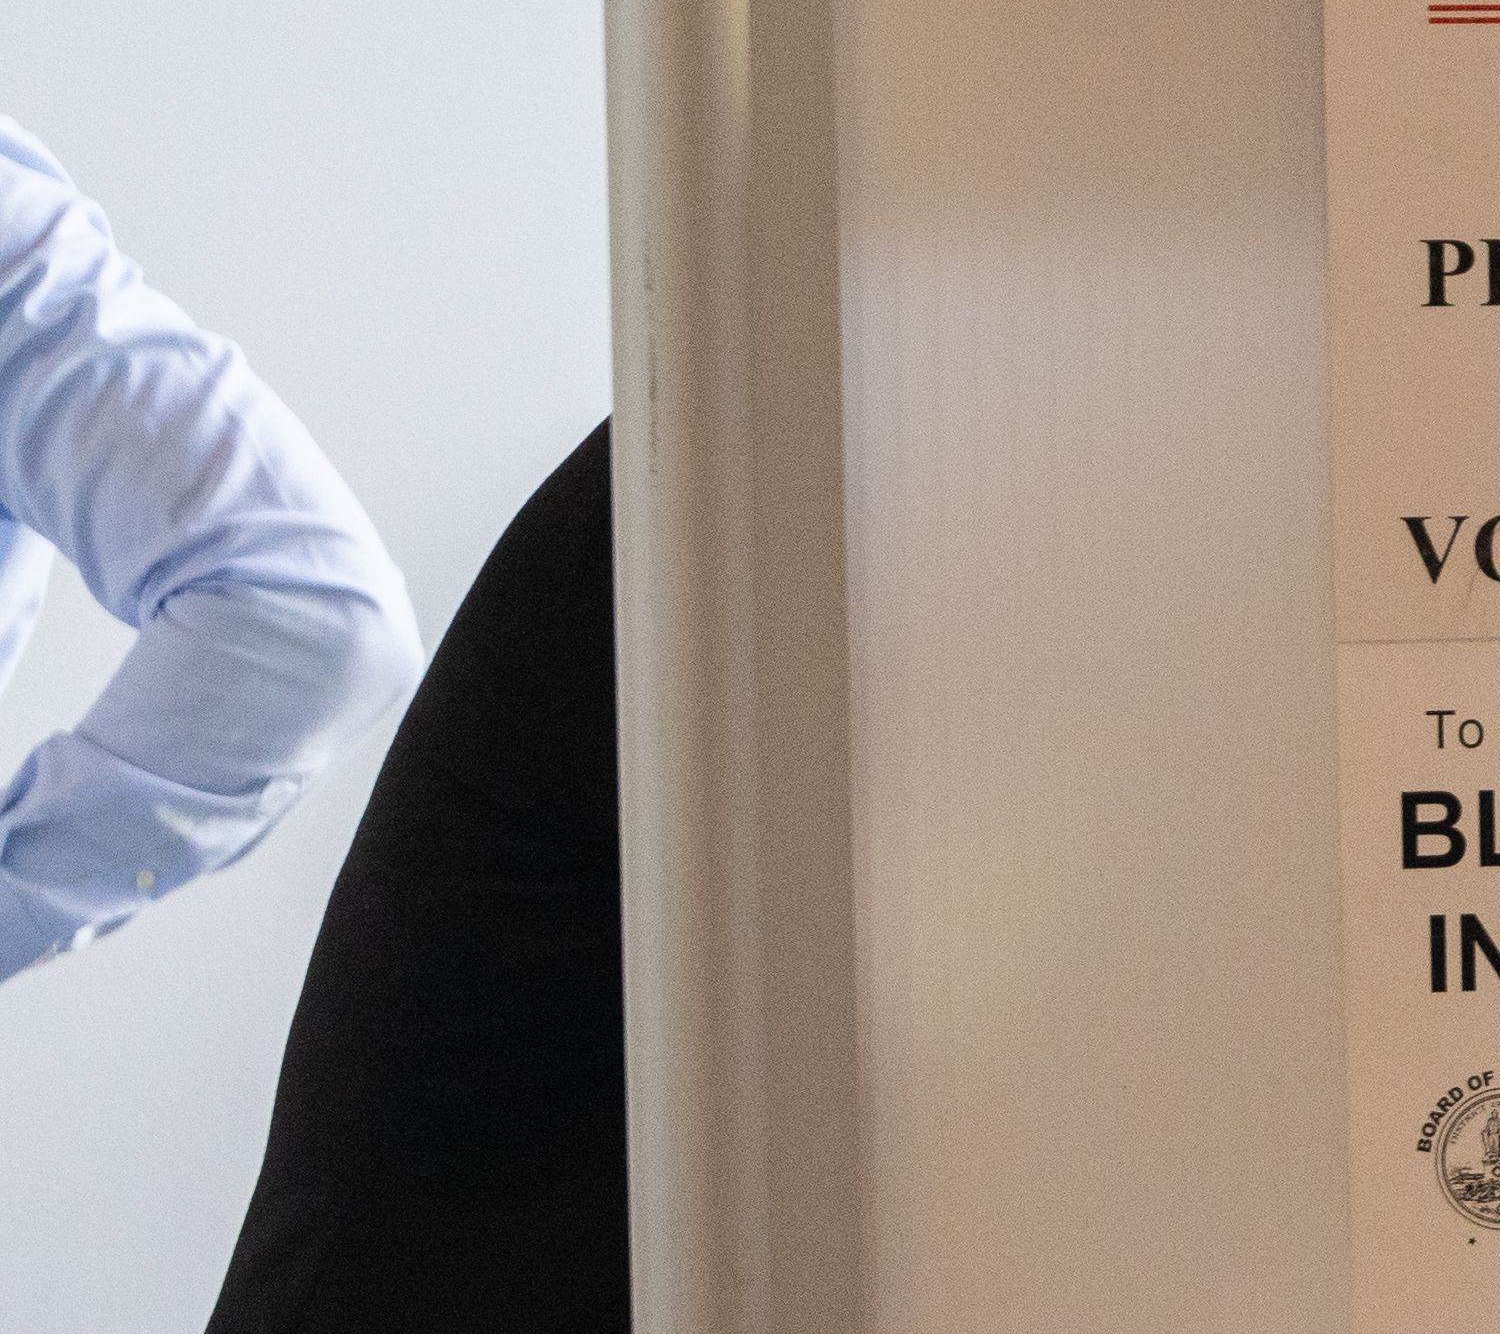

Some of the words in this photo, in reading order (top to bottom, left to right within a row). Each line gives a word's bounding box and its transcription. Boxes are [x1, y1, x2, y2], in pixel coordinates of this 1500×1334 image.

[1424, 708, 1485, 750] To
[1417, 1086, 1464, 1153] BOARD
[1467, 1070, 1494, 1091] OF
